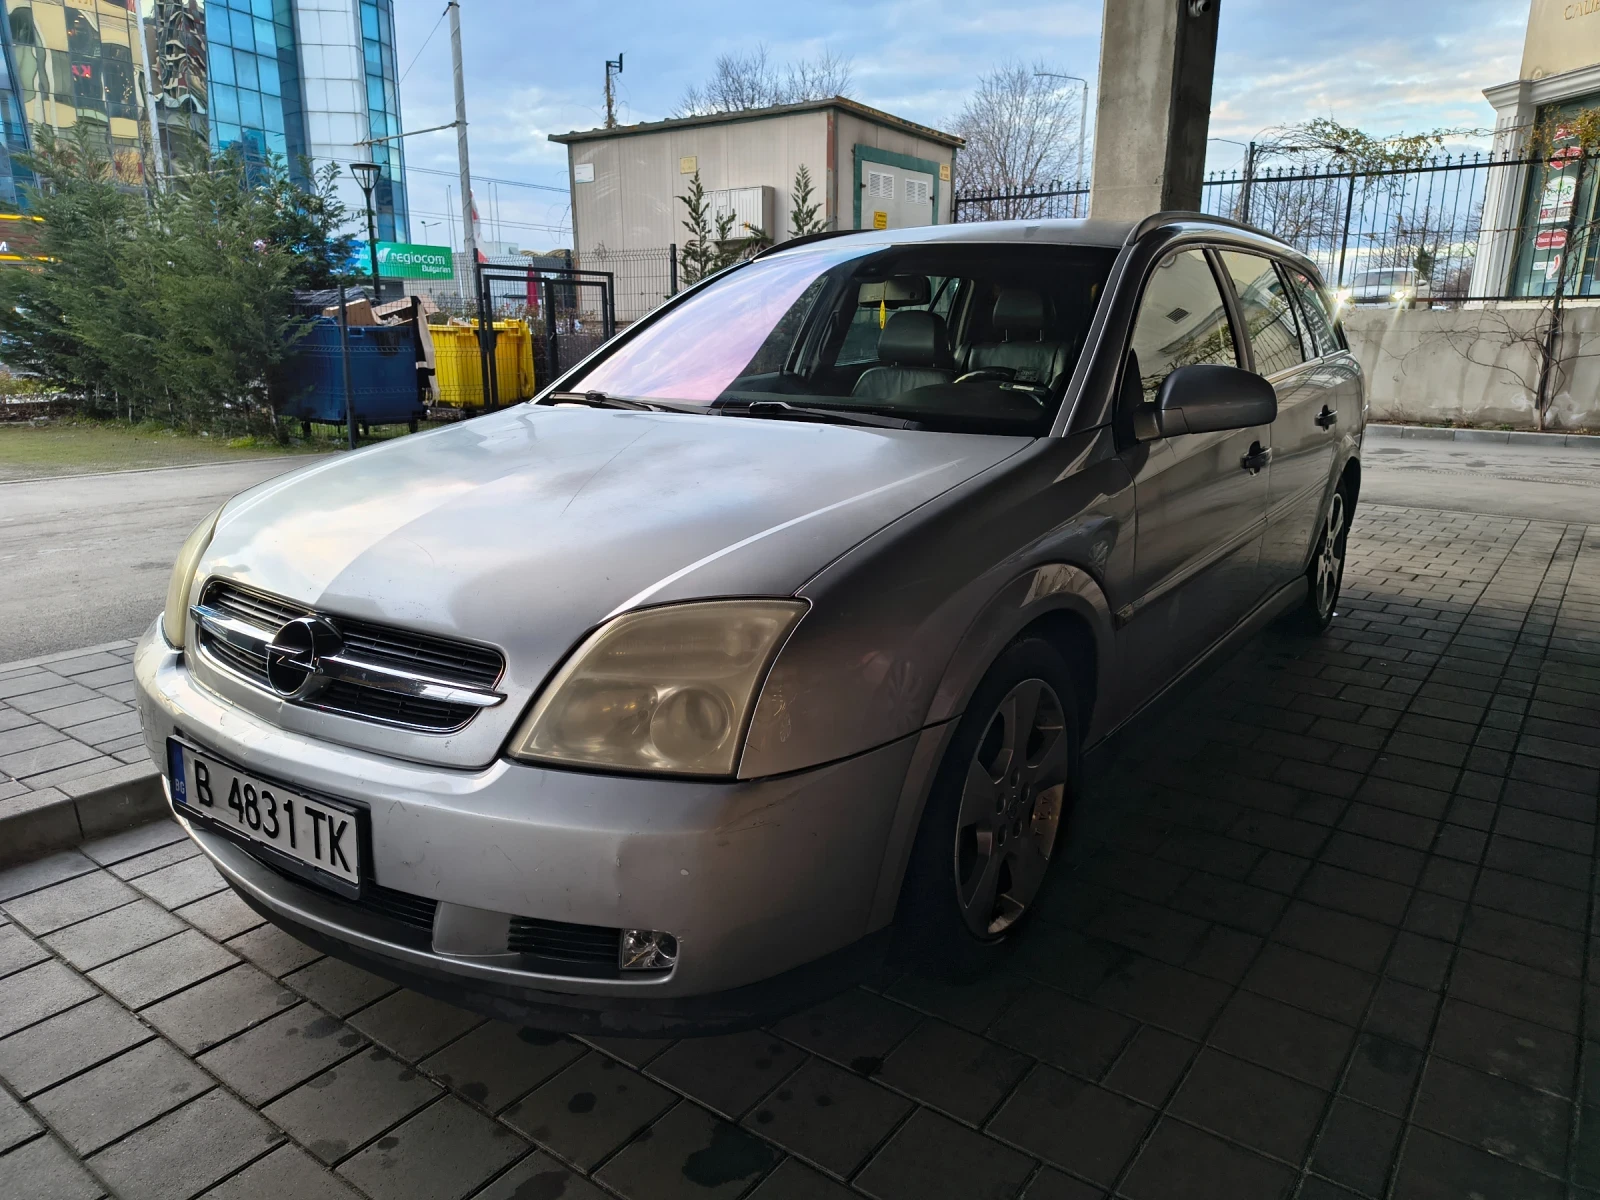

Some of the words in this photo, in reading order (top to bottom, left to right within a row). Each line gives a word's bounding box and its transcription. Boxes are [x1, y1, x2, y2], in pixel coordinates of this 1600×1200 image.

[391, 252, 445, 264] regiocom
[175, 779, 185, 794] BG
[194, 759, 213, 807] B
